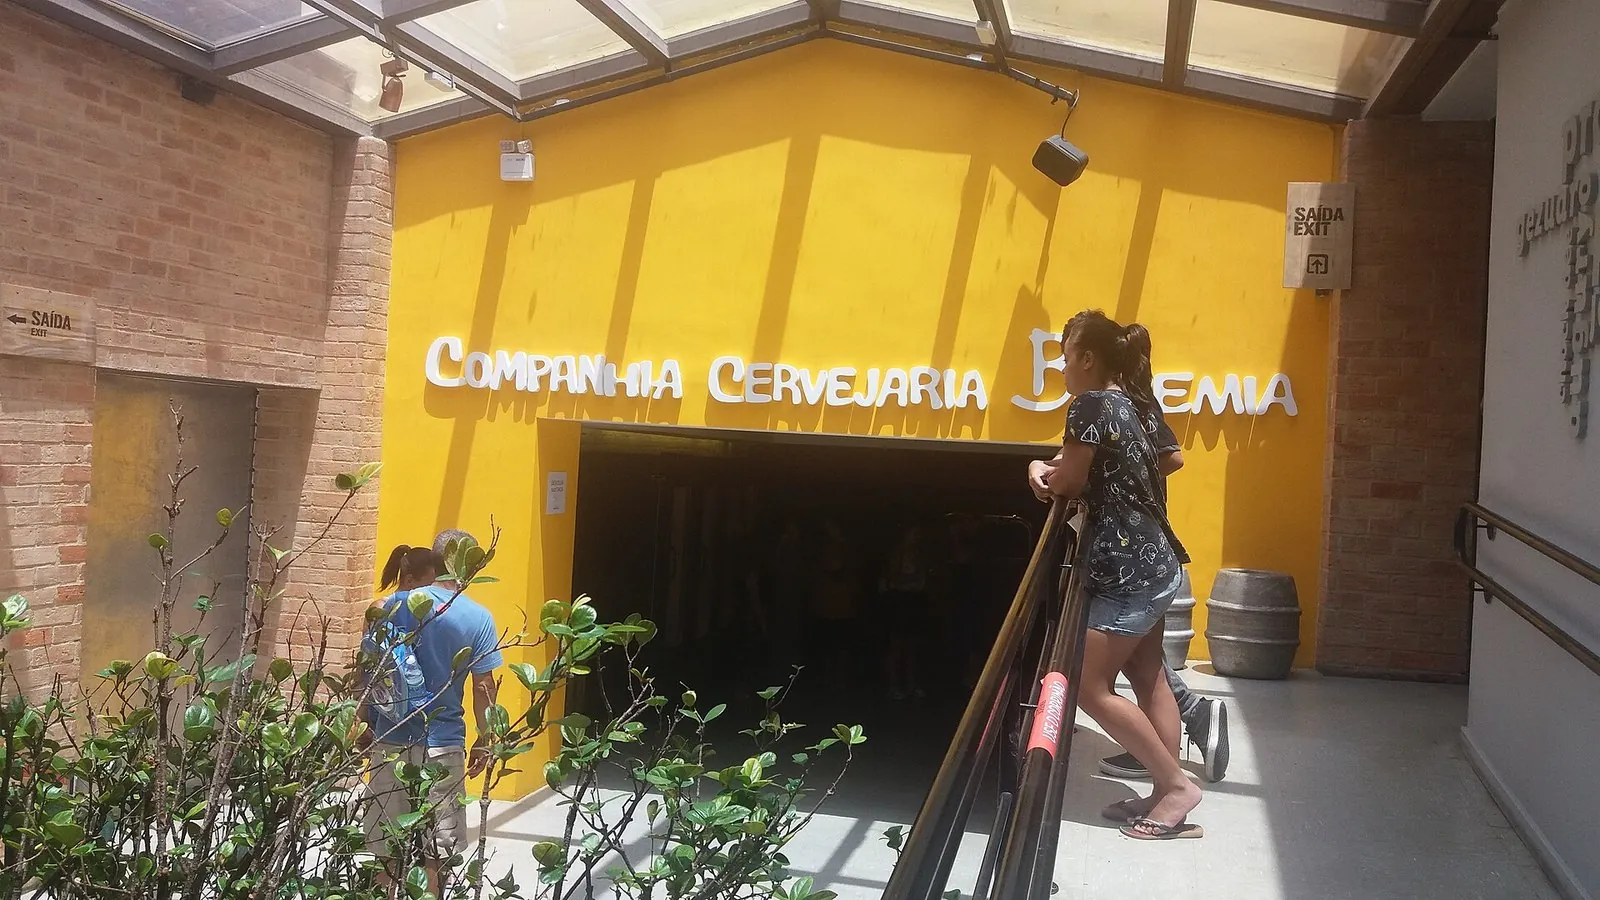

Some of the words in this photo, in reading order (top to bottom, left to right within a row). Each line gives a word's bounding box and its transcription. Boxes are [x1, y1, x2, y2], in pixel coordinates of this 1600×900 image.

[1294, 204, 1344, 221] SAÍDA
[1293, 222, 1331, 236] EXIT
[32, 310, 71, 330] SAÍDA
[31, 328, 47, 337] EXIT
[425, 336, 683, 399] COMPANHIA
[708, 356, 988, 410] CERVEJARIA
[1011, 328, 1298, 417] BEMIA
[1047, 681, 1066, 721] CORRIMÃO
[1042, 722, 1057, 744] USE
